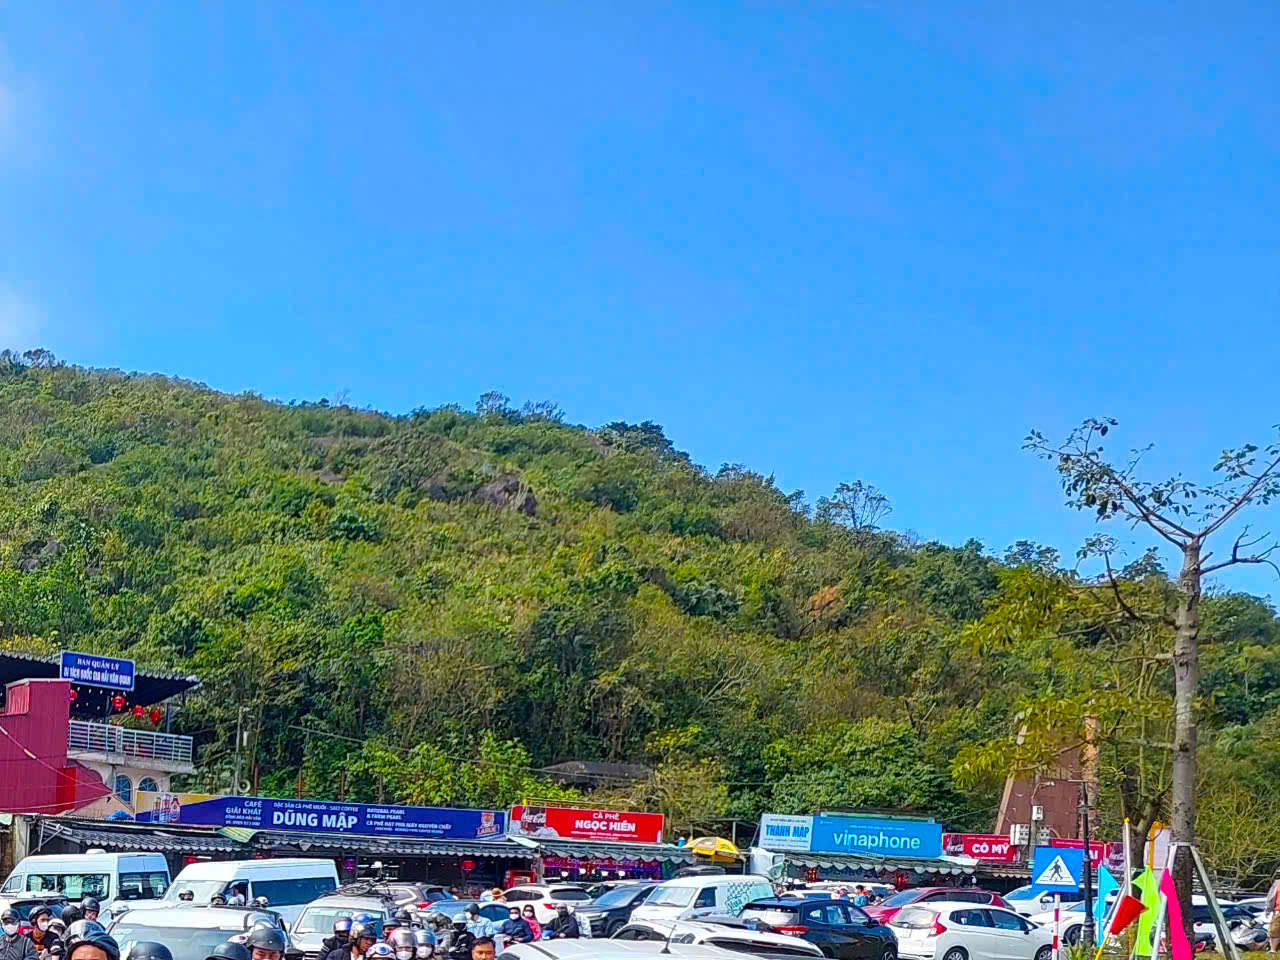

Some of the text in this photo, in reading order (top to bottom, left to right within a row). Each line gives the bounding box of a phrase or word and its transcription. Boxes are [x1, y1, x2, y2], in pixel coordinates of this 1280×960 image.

[77, 658, 91, 667] BAN
[244, 800, 263, 808] CAFÉ
[225, 806, 262, 815] GIẢI KHÁT
[273, 809, 358, 832] DŨNG MẬP
[575, 820, 607, 832] NGỌC
[765, 824, 791, 837] THANH
[833, 829, 921, 850] vinaphone
[972, 842, 989, 853] CÔ
[991, 842, 1010, 854] MỸ
